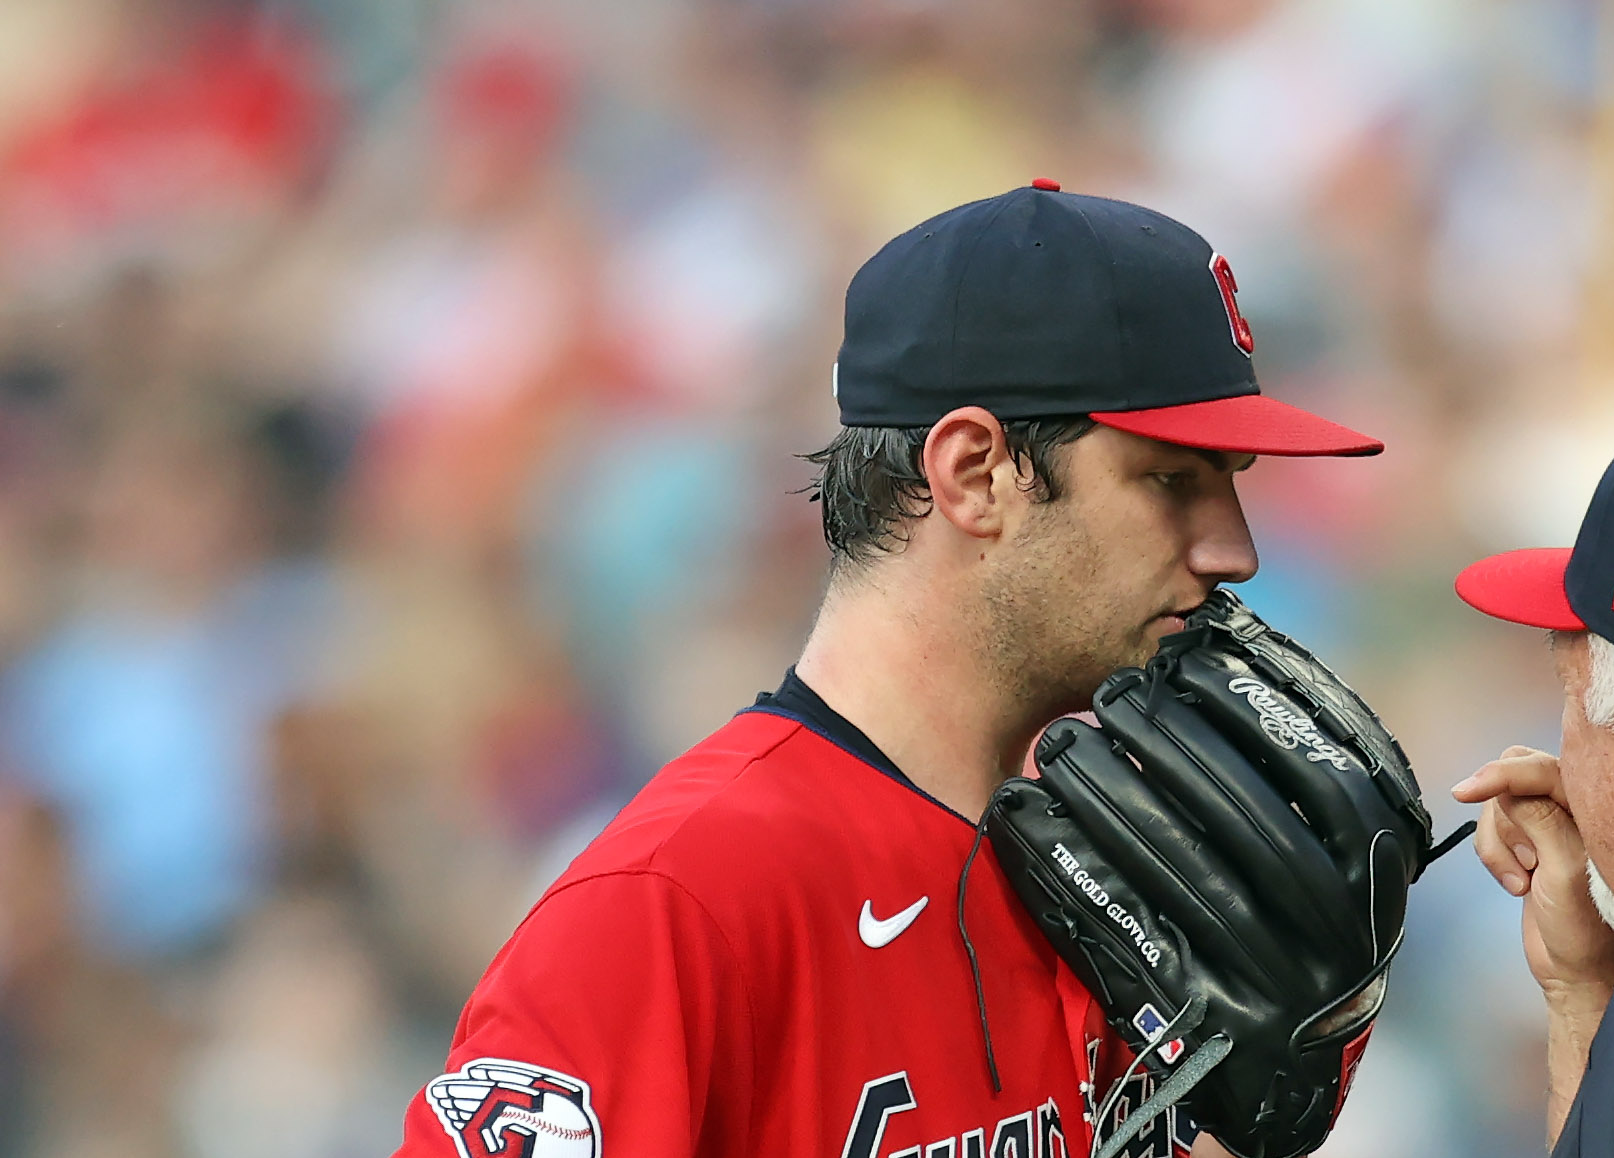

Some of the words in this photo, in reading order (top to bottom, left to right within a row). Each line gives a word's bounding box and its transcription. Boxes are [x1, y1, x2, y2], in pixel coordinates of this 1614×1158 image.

[1228, 677, 1350, 771] Rawlings
[1051, 843, 1080, 875] THE
[1073, 870, 1109, 906] GOLD
[1141, 941, 1161, 967] CO.
